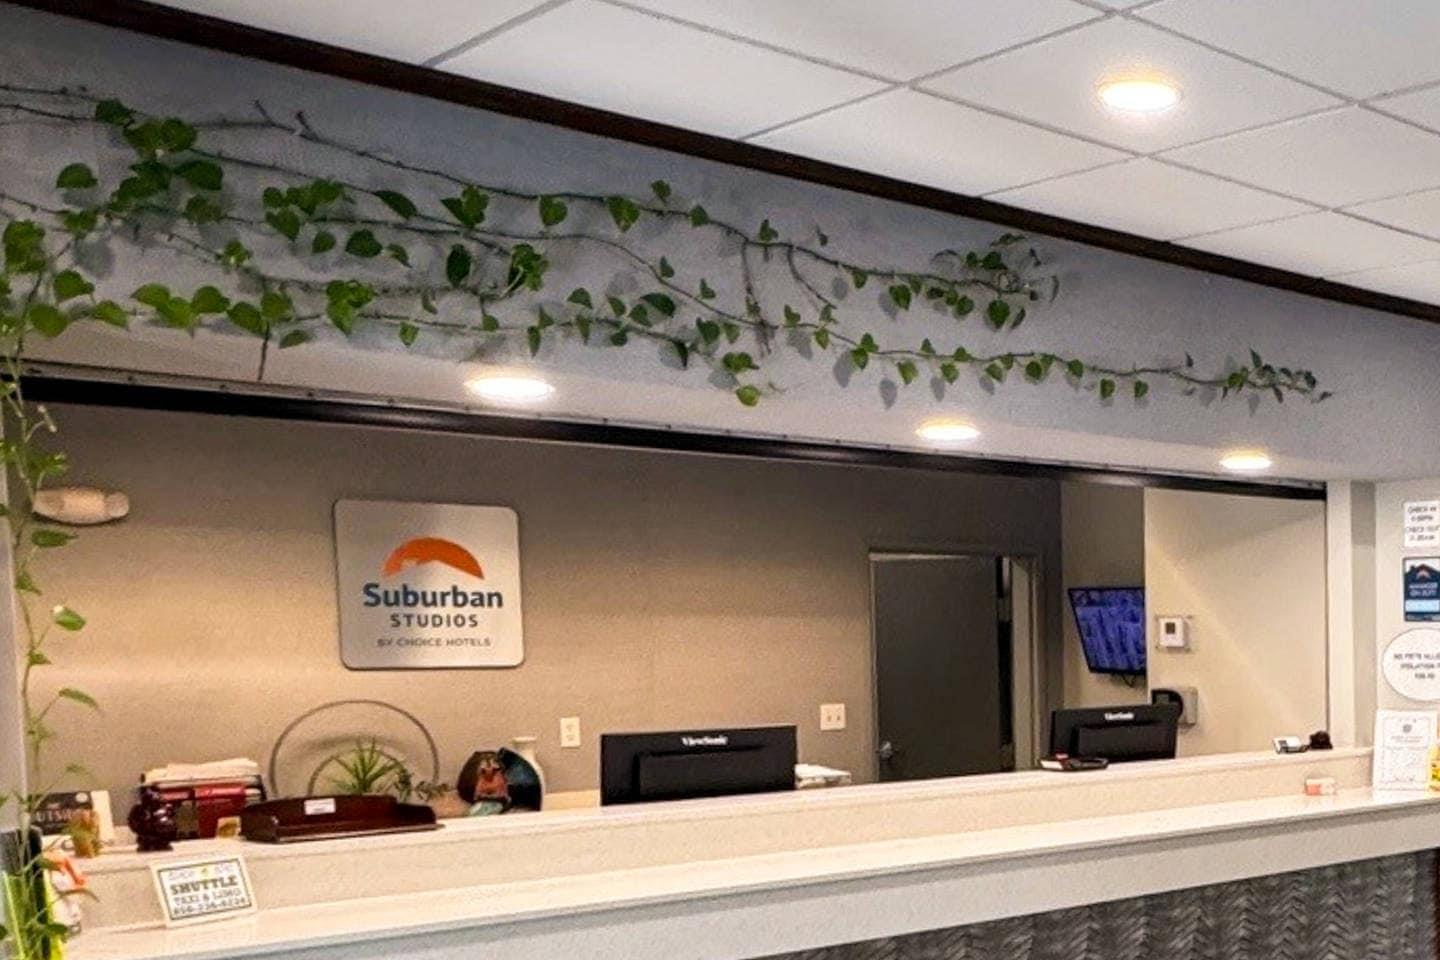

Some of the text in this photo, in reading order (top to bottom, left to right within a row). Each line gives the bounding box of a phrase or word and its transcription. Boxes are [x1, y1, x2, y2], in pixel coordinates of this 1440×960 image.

[362, 583, 504, 608] Suburban
[390, 613, 478, 628] STUDIOS
[377, 637, 491, 647] BY CHOICE HOTELS
[170, 875, 238, 895] SHUTTLE
